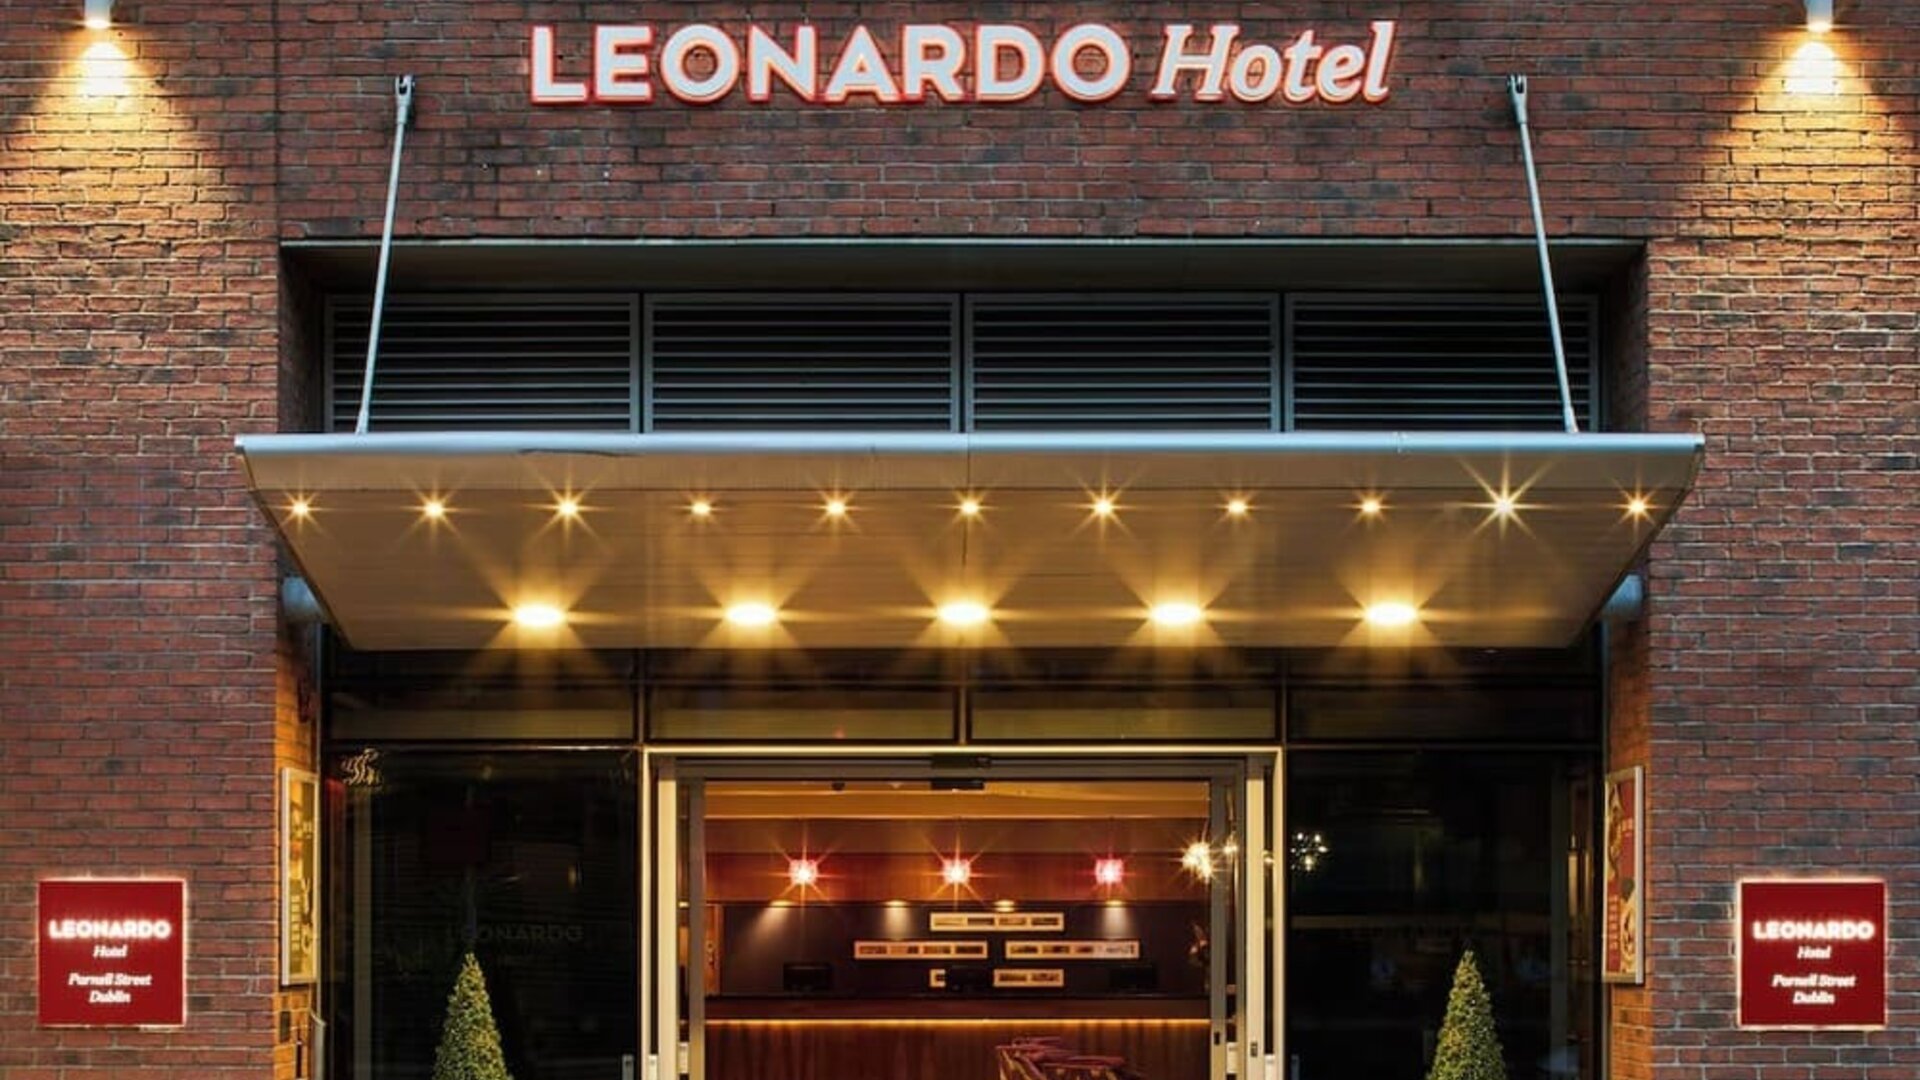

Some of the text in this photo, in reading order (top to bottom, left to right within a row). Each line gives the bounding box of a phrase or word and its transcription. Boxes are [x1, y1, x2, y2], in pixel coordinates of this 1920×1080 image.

[530, 19, 1396, 104] LEONARDO Hotel
[49, 919, 171, 939] LEONARDO
[1752, 921, 1875, 940] LEONARDO
[93, 944, 128, 958] Hotel
[1797, 945, 1832, 959] Hotel
[114, 974, 152, 985] Street
[1818, 975, 1856, 987] Street
[89, 989, 131, 1003] Dublin
[1792, 991, 1835, 1004] Dublin
